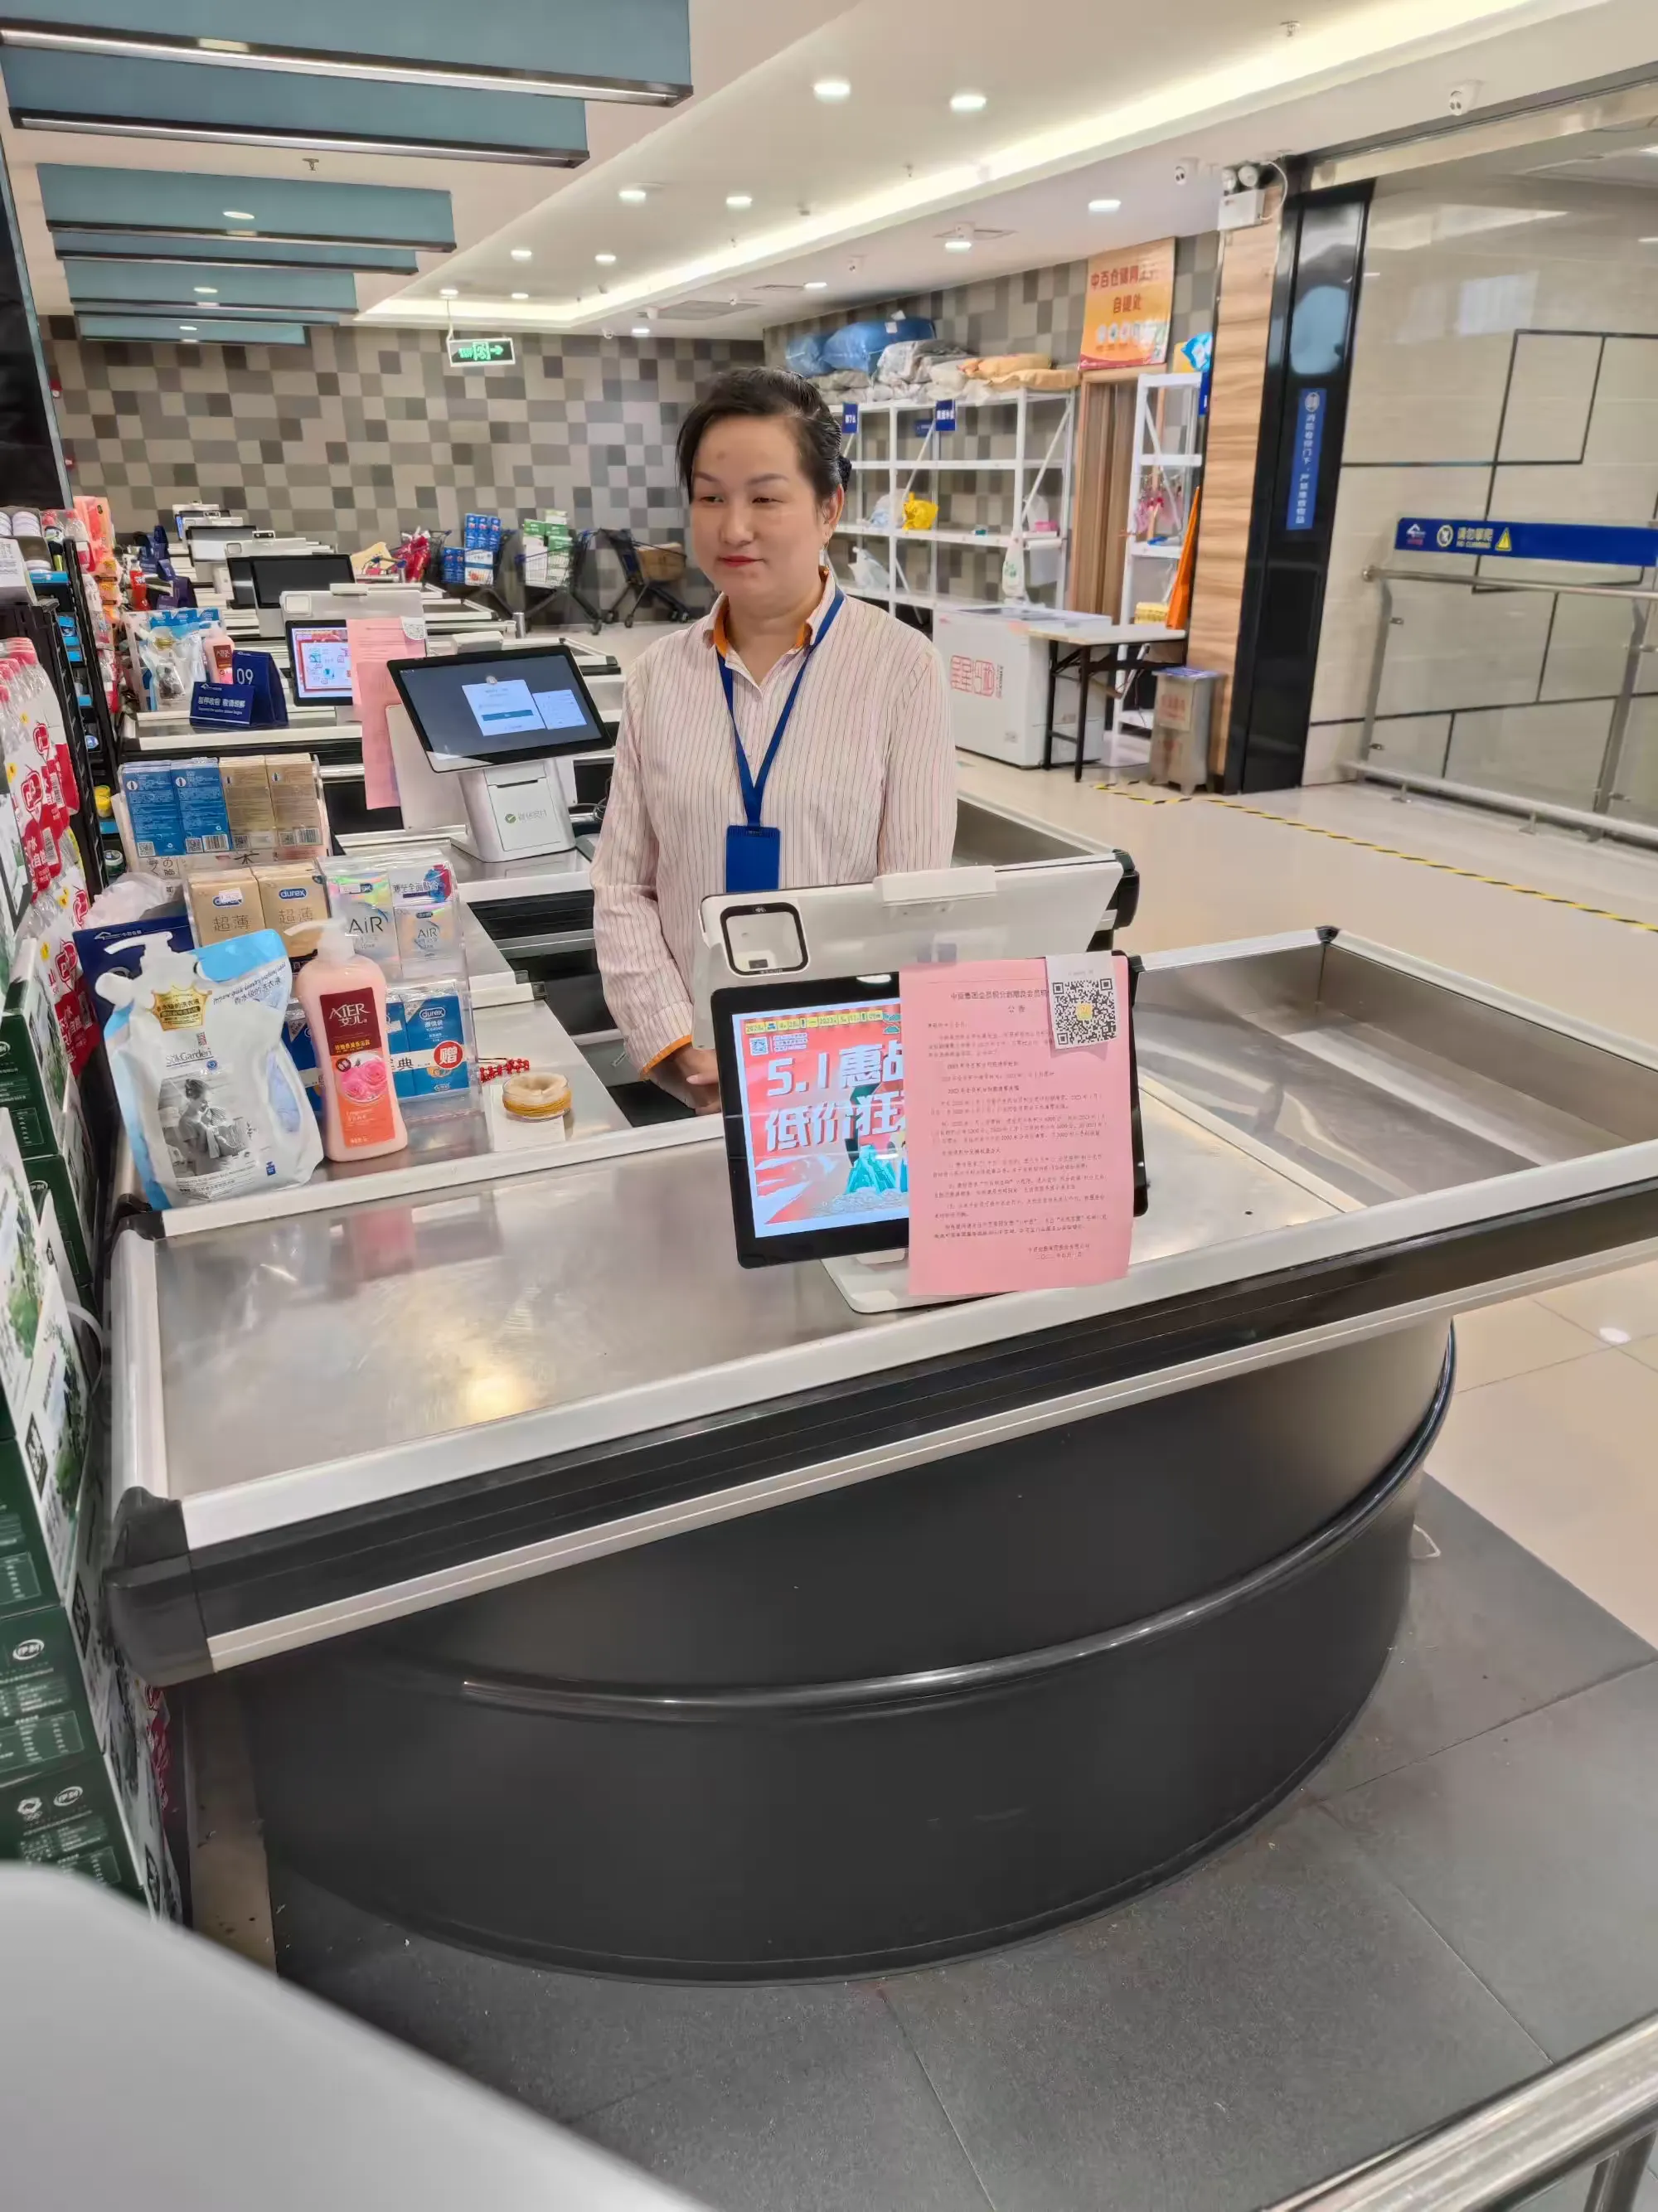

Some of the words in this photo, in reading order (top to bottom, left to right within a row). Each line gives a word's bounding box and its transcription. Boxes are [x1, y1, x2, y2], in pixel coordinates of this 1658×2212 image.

[236, 667, 254, 685] 09
[280, 889, 306, 899] durex
[212, 914, 250, 932] 超薄
[279, 907, 313, 924] 超薄
[421, 1008, 445, 1019] durex
[439, 1046, 458, 1065] 赠
